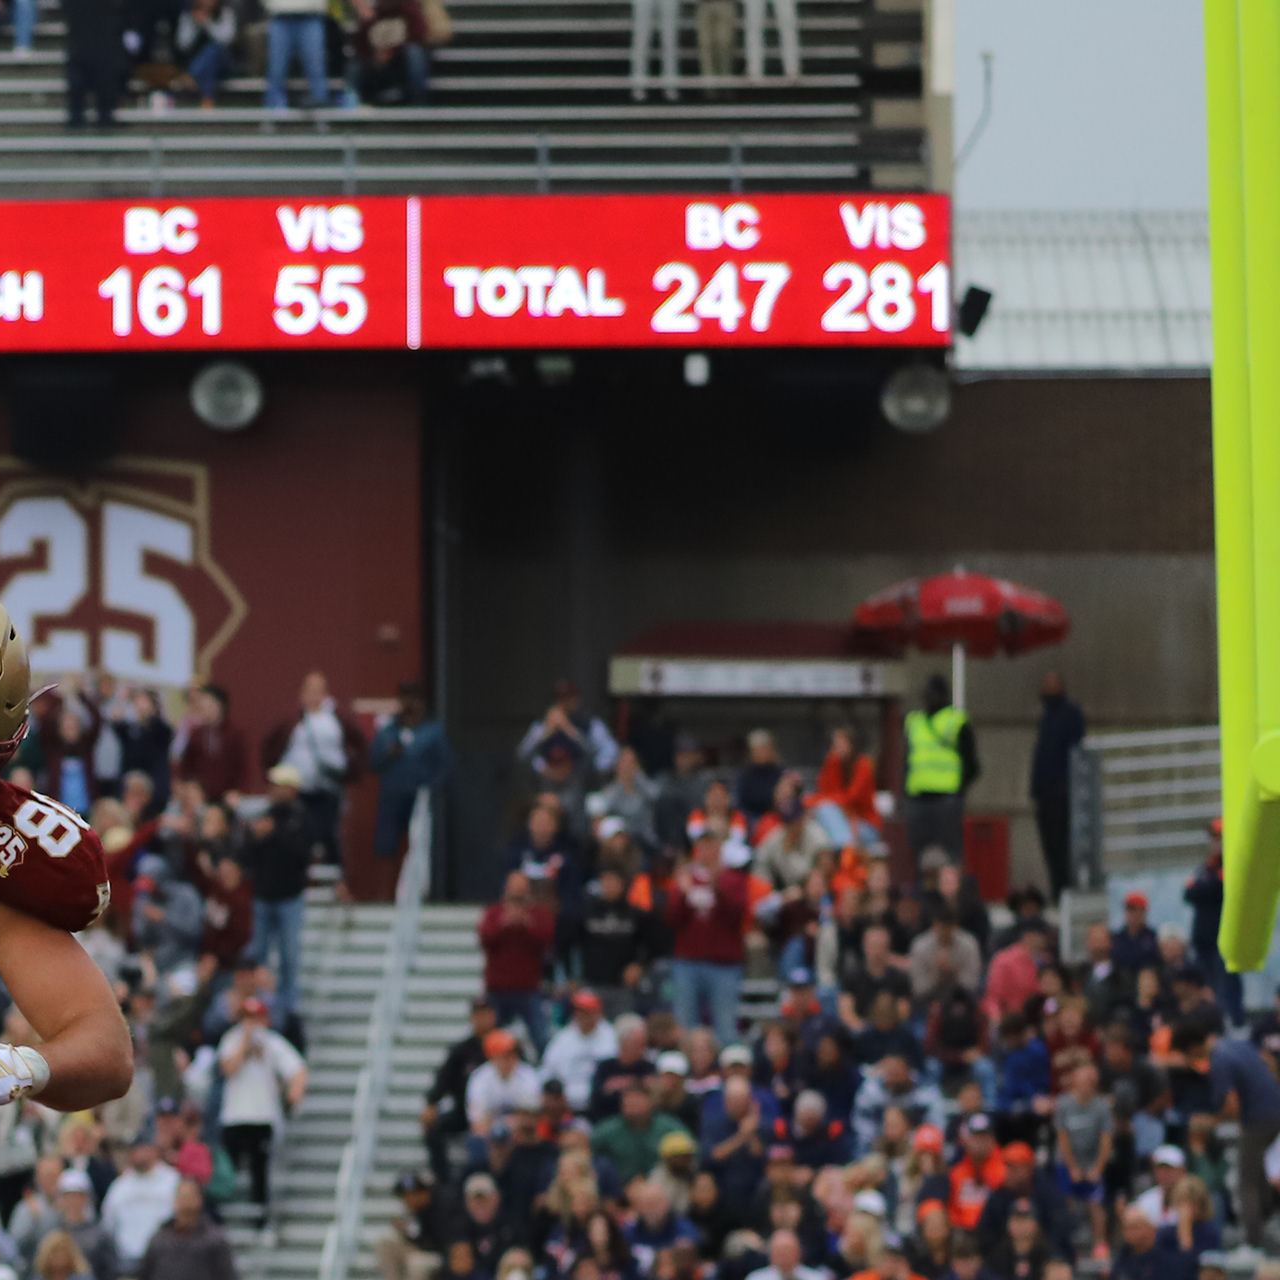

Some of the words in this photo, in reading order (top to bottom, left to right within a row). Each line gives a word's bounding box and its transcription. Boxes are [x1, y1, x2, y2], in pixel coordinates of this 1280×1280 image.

[124, 207, 199, 254] BC
[276, 205, 364, 252] VIS
[685, 202, 760, 250] BC
[839, 203, 927, 249] VIS
[98, 264, 222, 336] 161
[273, 265, 368, 335] 55
[444, 266, 625, 317] TOTAL
[651, 262, 791, 333] 247
[821, 262, 950, 333] 281
